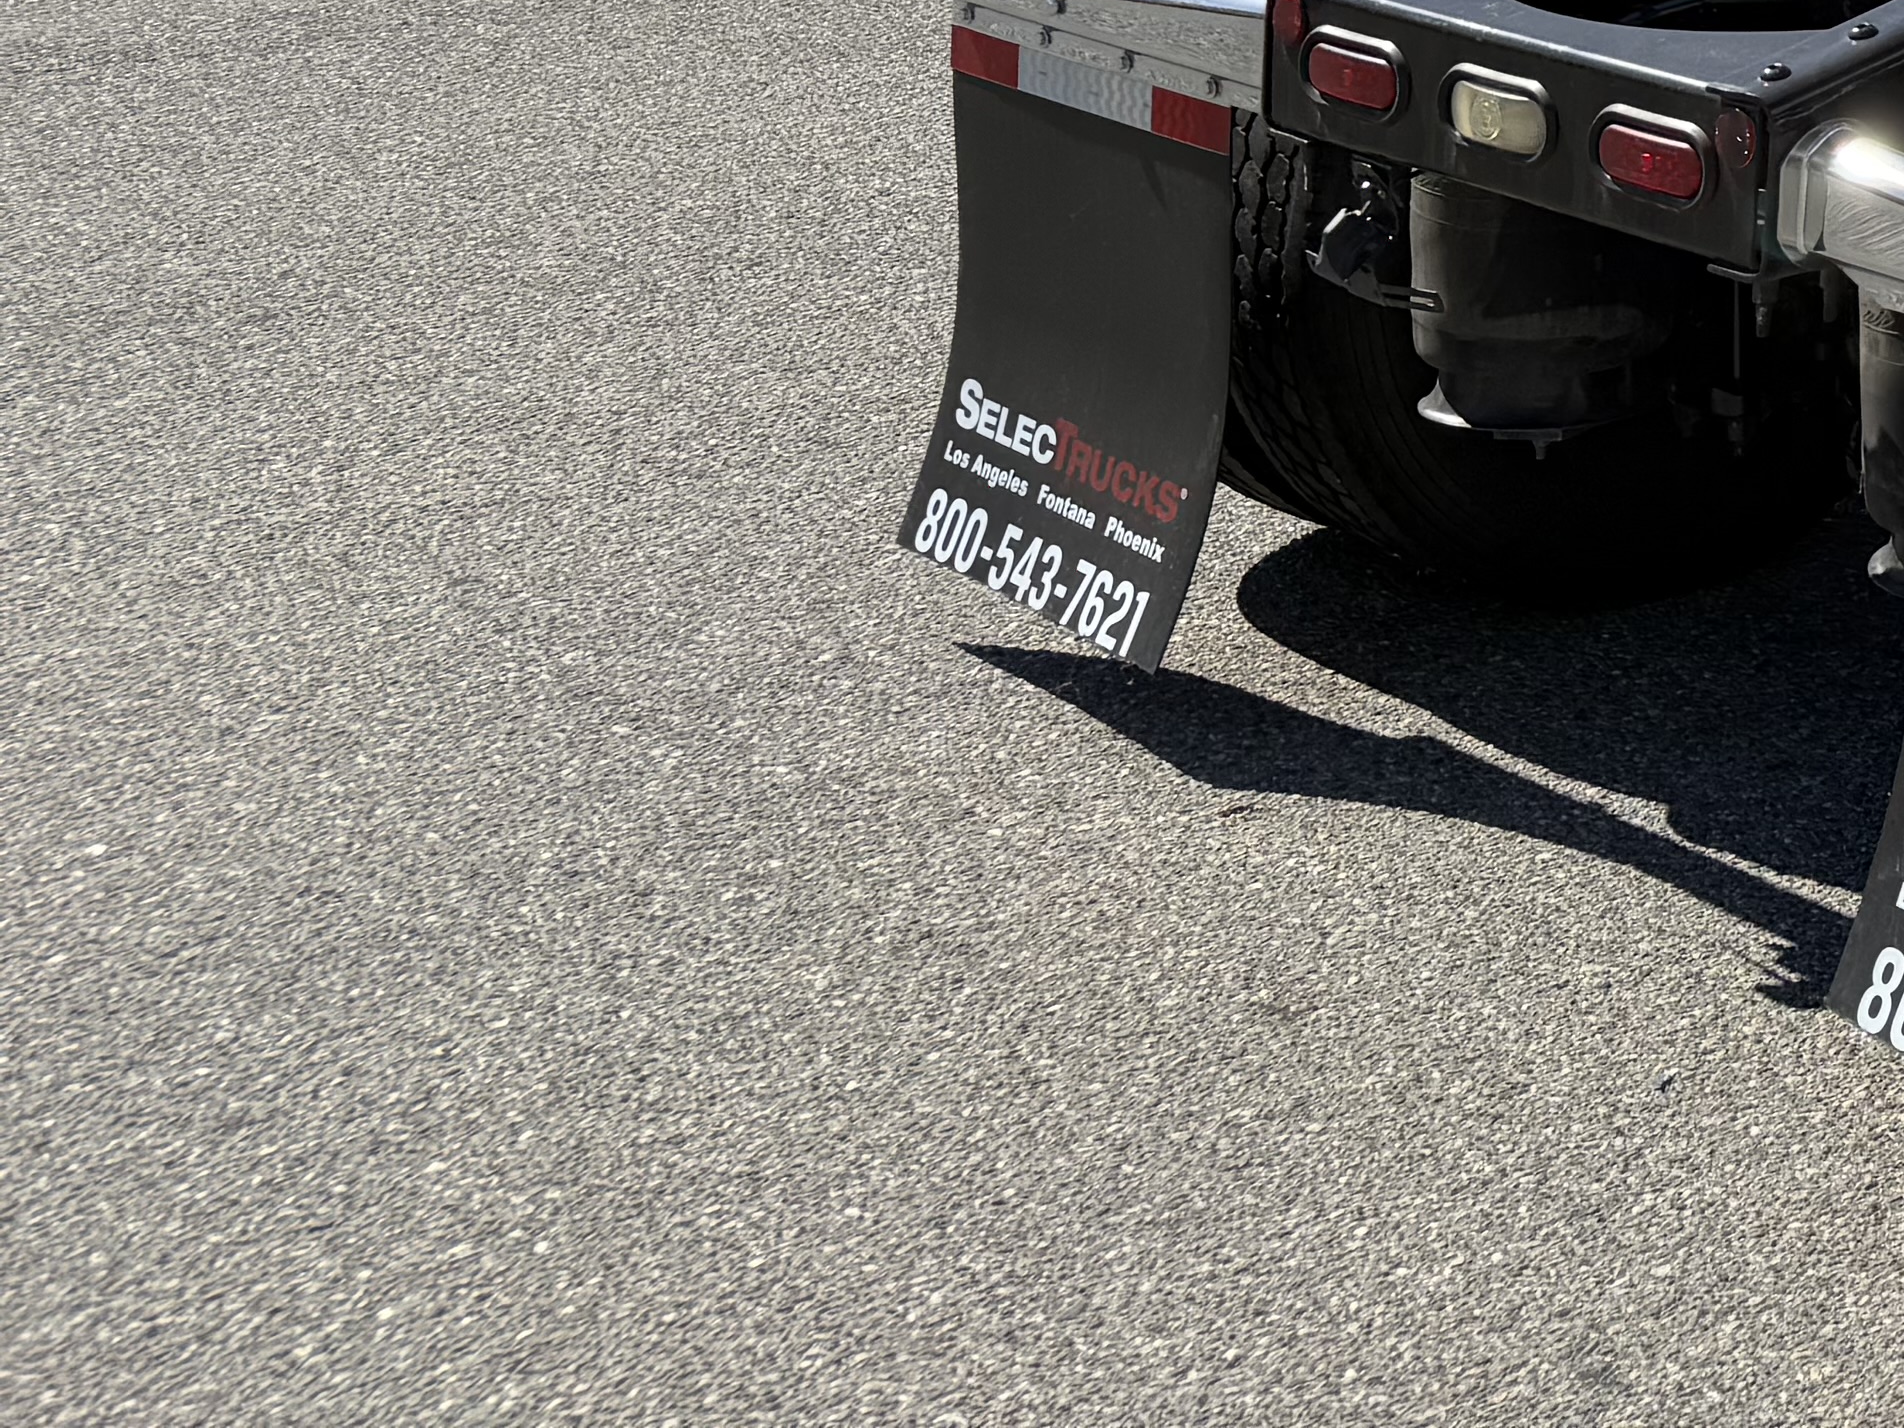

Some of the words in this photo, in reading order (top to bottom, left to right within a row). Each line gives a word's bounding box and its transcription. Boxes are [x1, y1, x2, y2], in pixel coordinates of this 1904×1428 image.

[914, 488, 1151, 658] 800-543-7621
[943, 440, 970, 469] Los
[971, 454, 1029, 497] Angeles
[1037, 485, 1096, 530] Fontana
[1104, 516, 1165, 563] Phoenix
